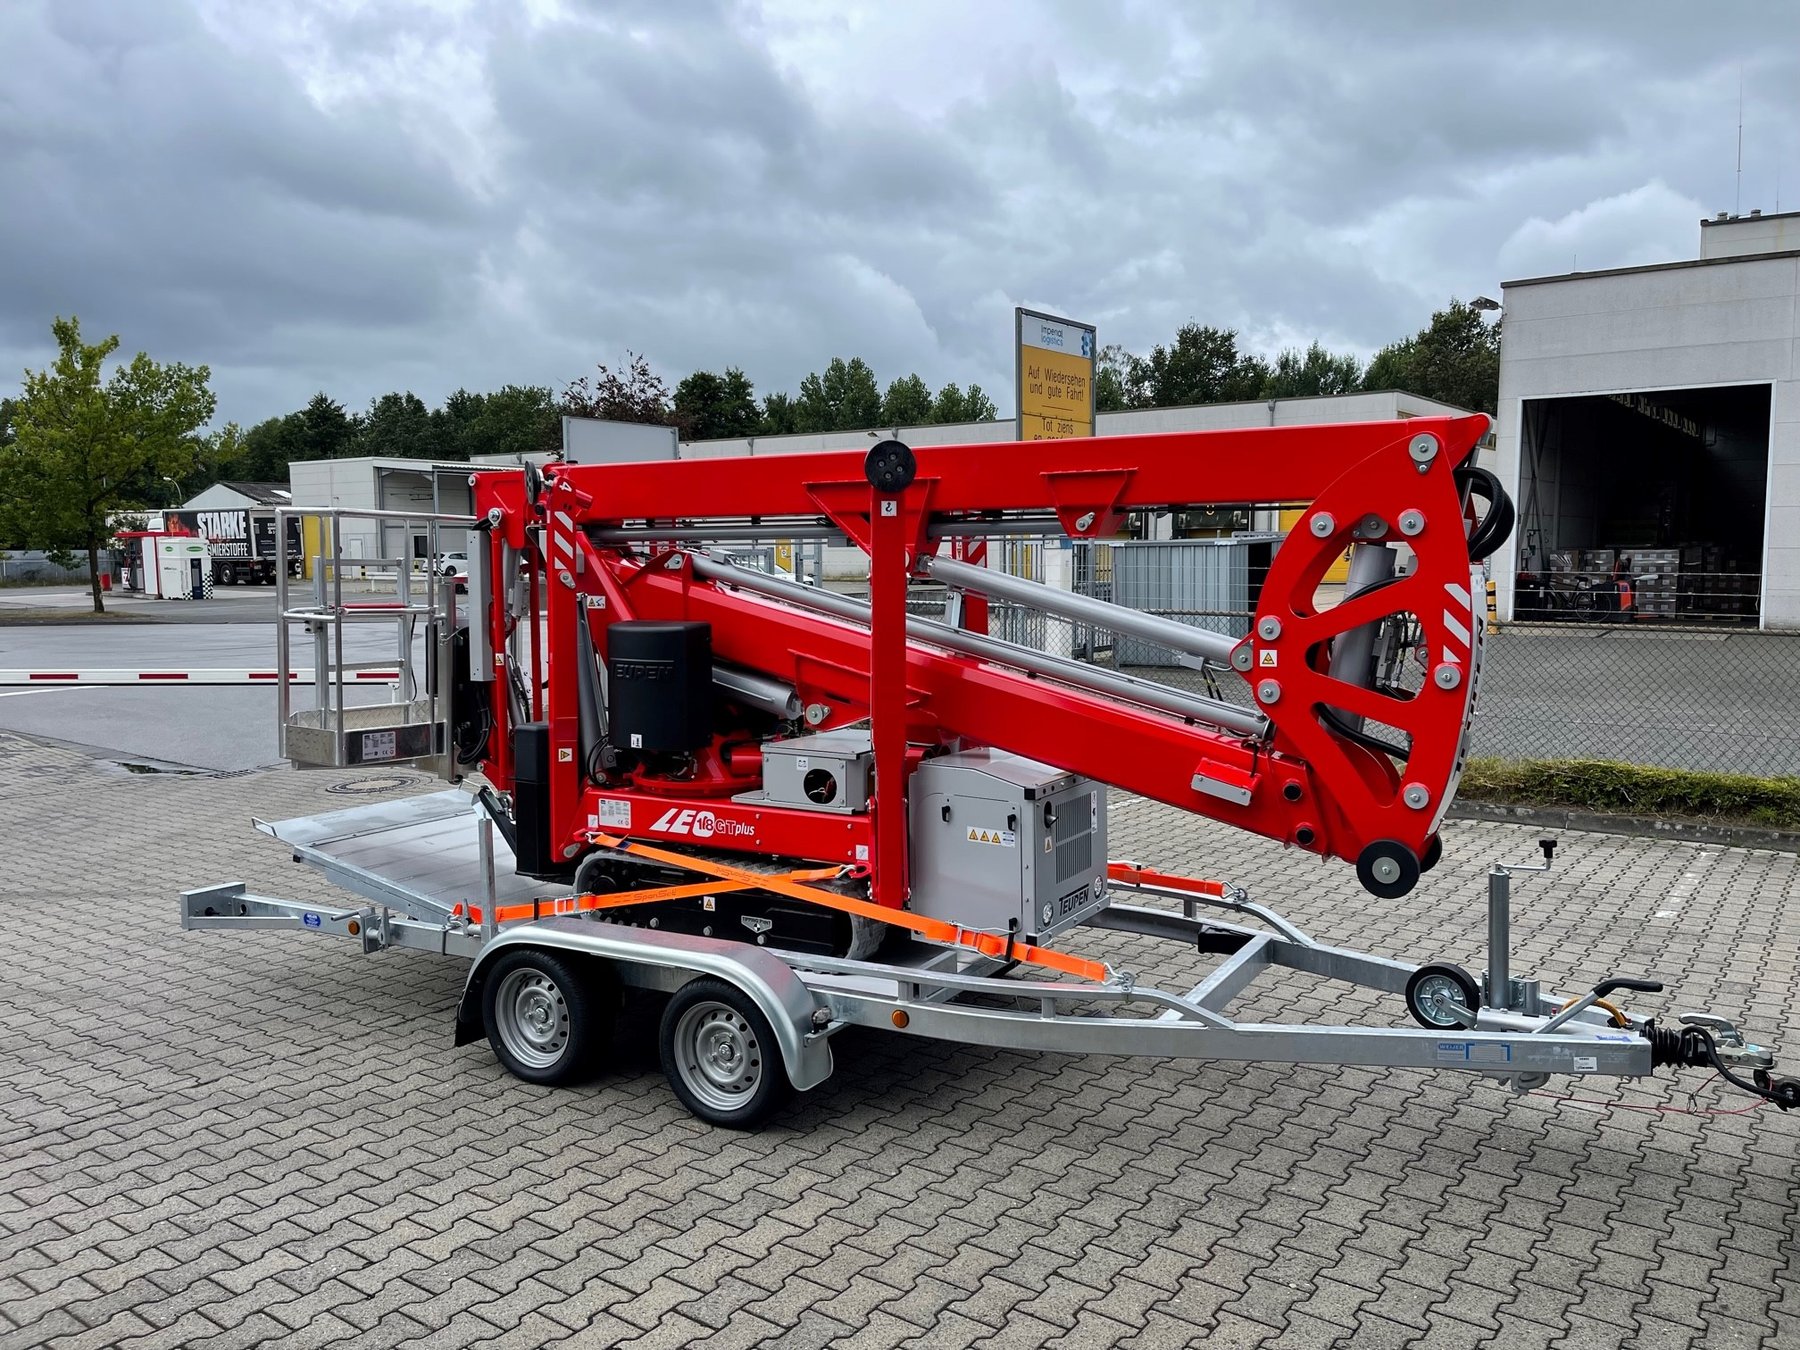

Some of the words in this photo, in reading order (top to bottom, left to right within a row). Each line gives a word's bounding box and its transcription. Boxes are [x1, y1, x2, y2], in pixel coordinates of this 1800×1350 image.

[1028, 365, 1040, 379] Auf
[1045, 367, 1085, 388] Wiedersehen
[1030, 382, 1042, 395] und
[1048, 386, 1062, 399] gute
[1066, 386, 1084, 401] Fahrt!
[1042, 417, 1053, 432] Tot
[1057, 422, 1073, 434] ziens
[197, 512, 247, 540] STARKE
[210, 543, 248, 557] MIERSTOFFE
[1058, 883, 1089, 916] TEUPEN
